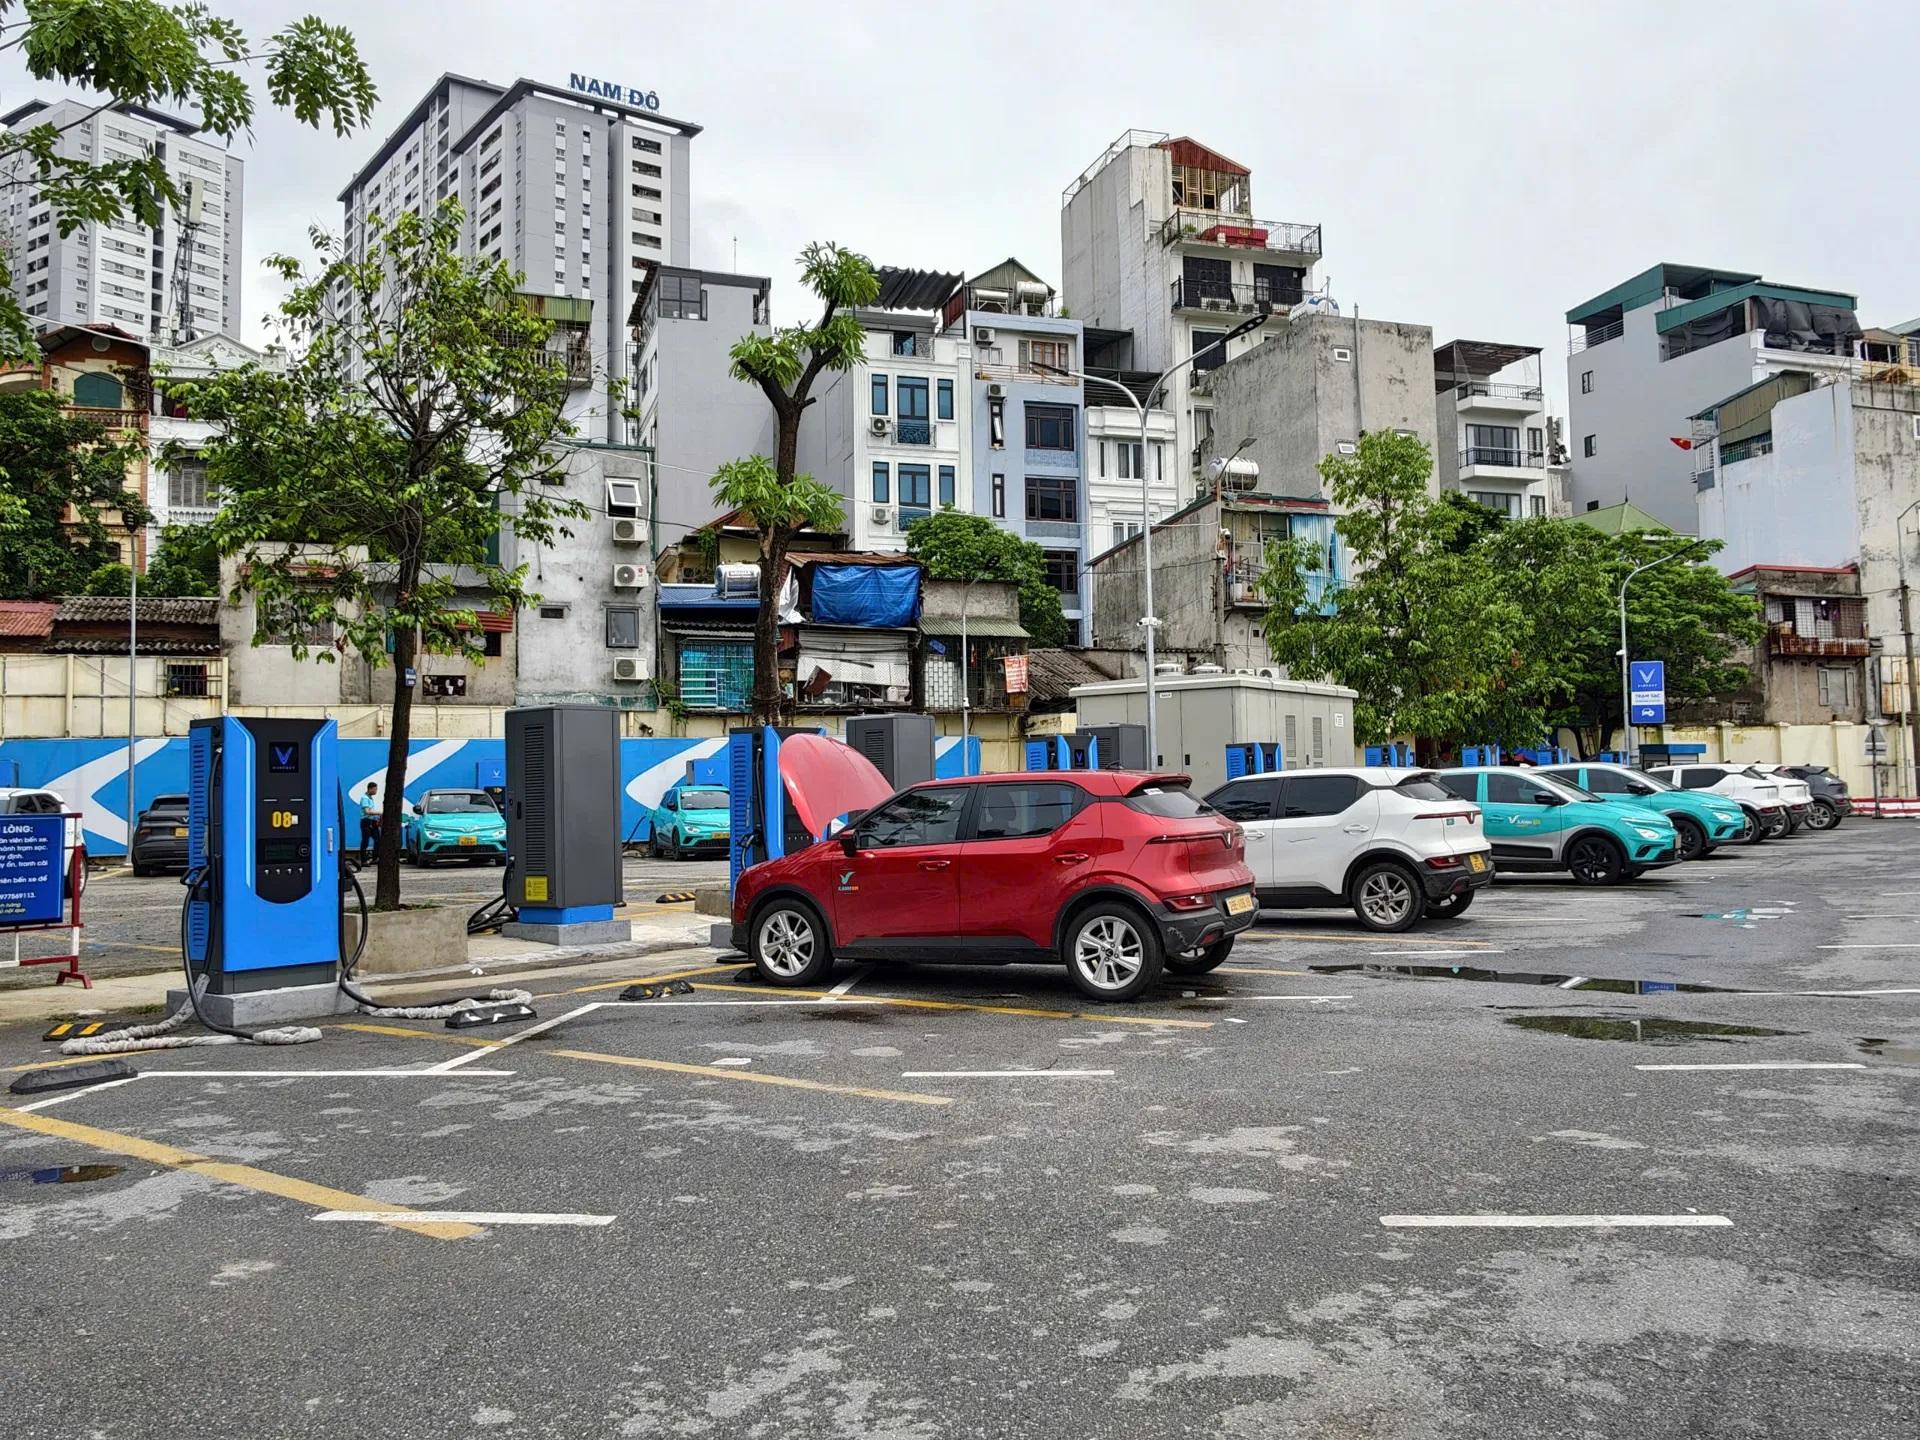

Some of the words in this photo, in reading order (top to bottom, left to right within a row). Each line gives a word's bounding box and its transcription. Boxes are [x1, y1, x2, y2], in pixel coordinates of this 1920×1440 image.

[570, 72, 621, 101] NAM
[628, 89, 660, 110] ĐÔ
[272, 811, 292, 828] 08
[3, 824, 34, 834] LÒNG:
